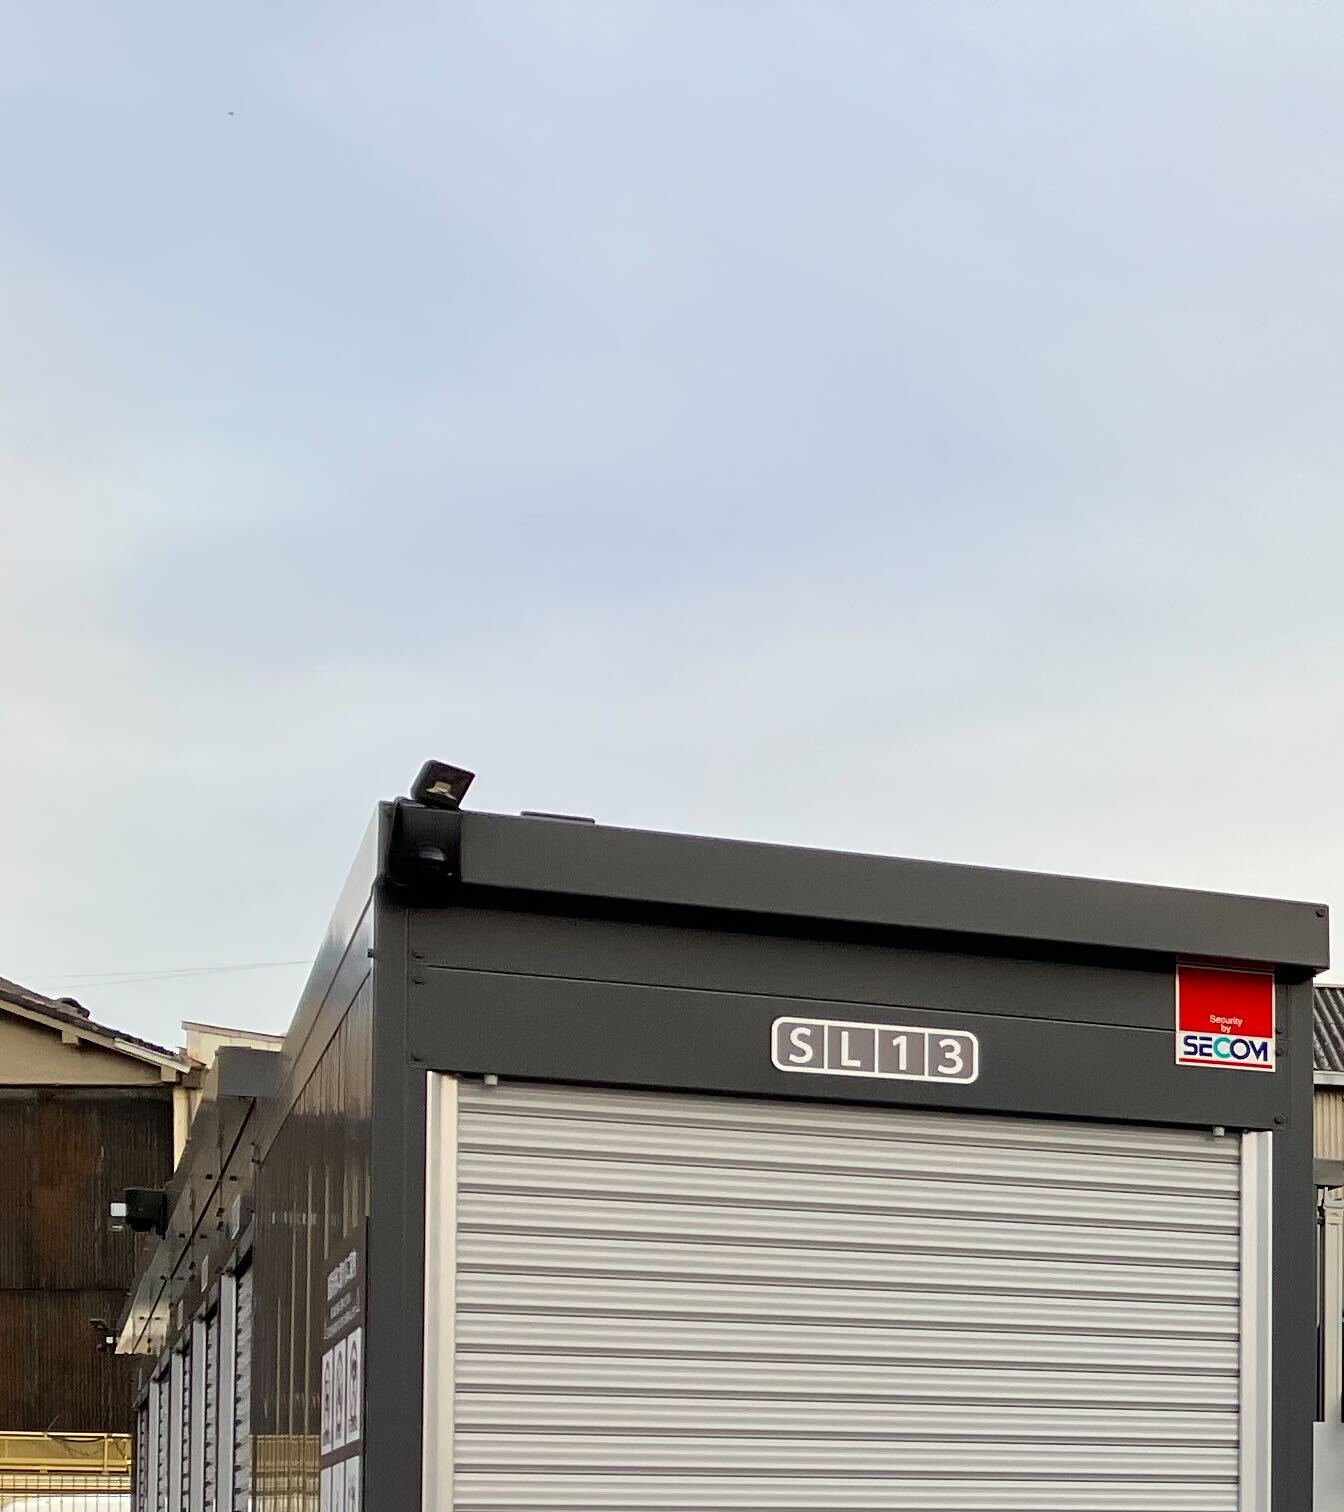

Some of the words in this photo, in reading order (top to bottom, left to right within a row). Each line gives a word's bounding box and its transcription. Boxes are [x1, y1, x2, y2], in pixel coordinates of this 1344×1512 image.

[1209, 1015, 1243, 1027] Security
[1220, 1024, 1232, 1034] by
[785, 1027, 966, 1075] SL13
[1183, 1035, 1268, 1062] SECOM
